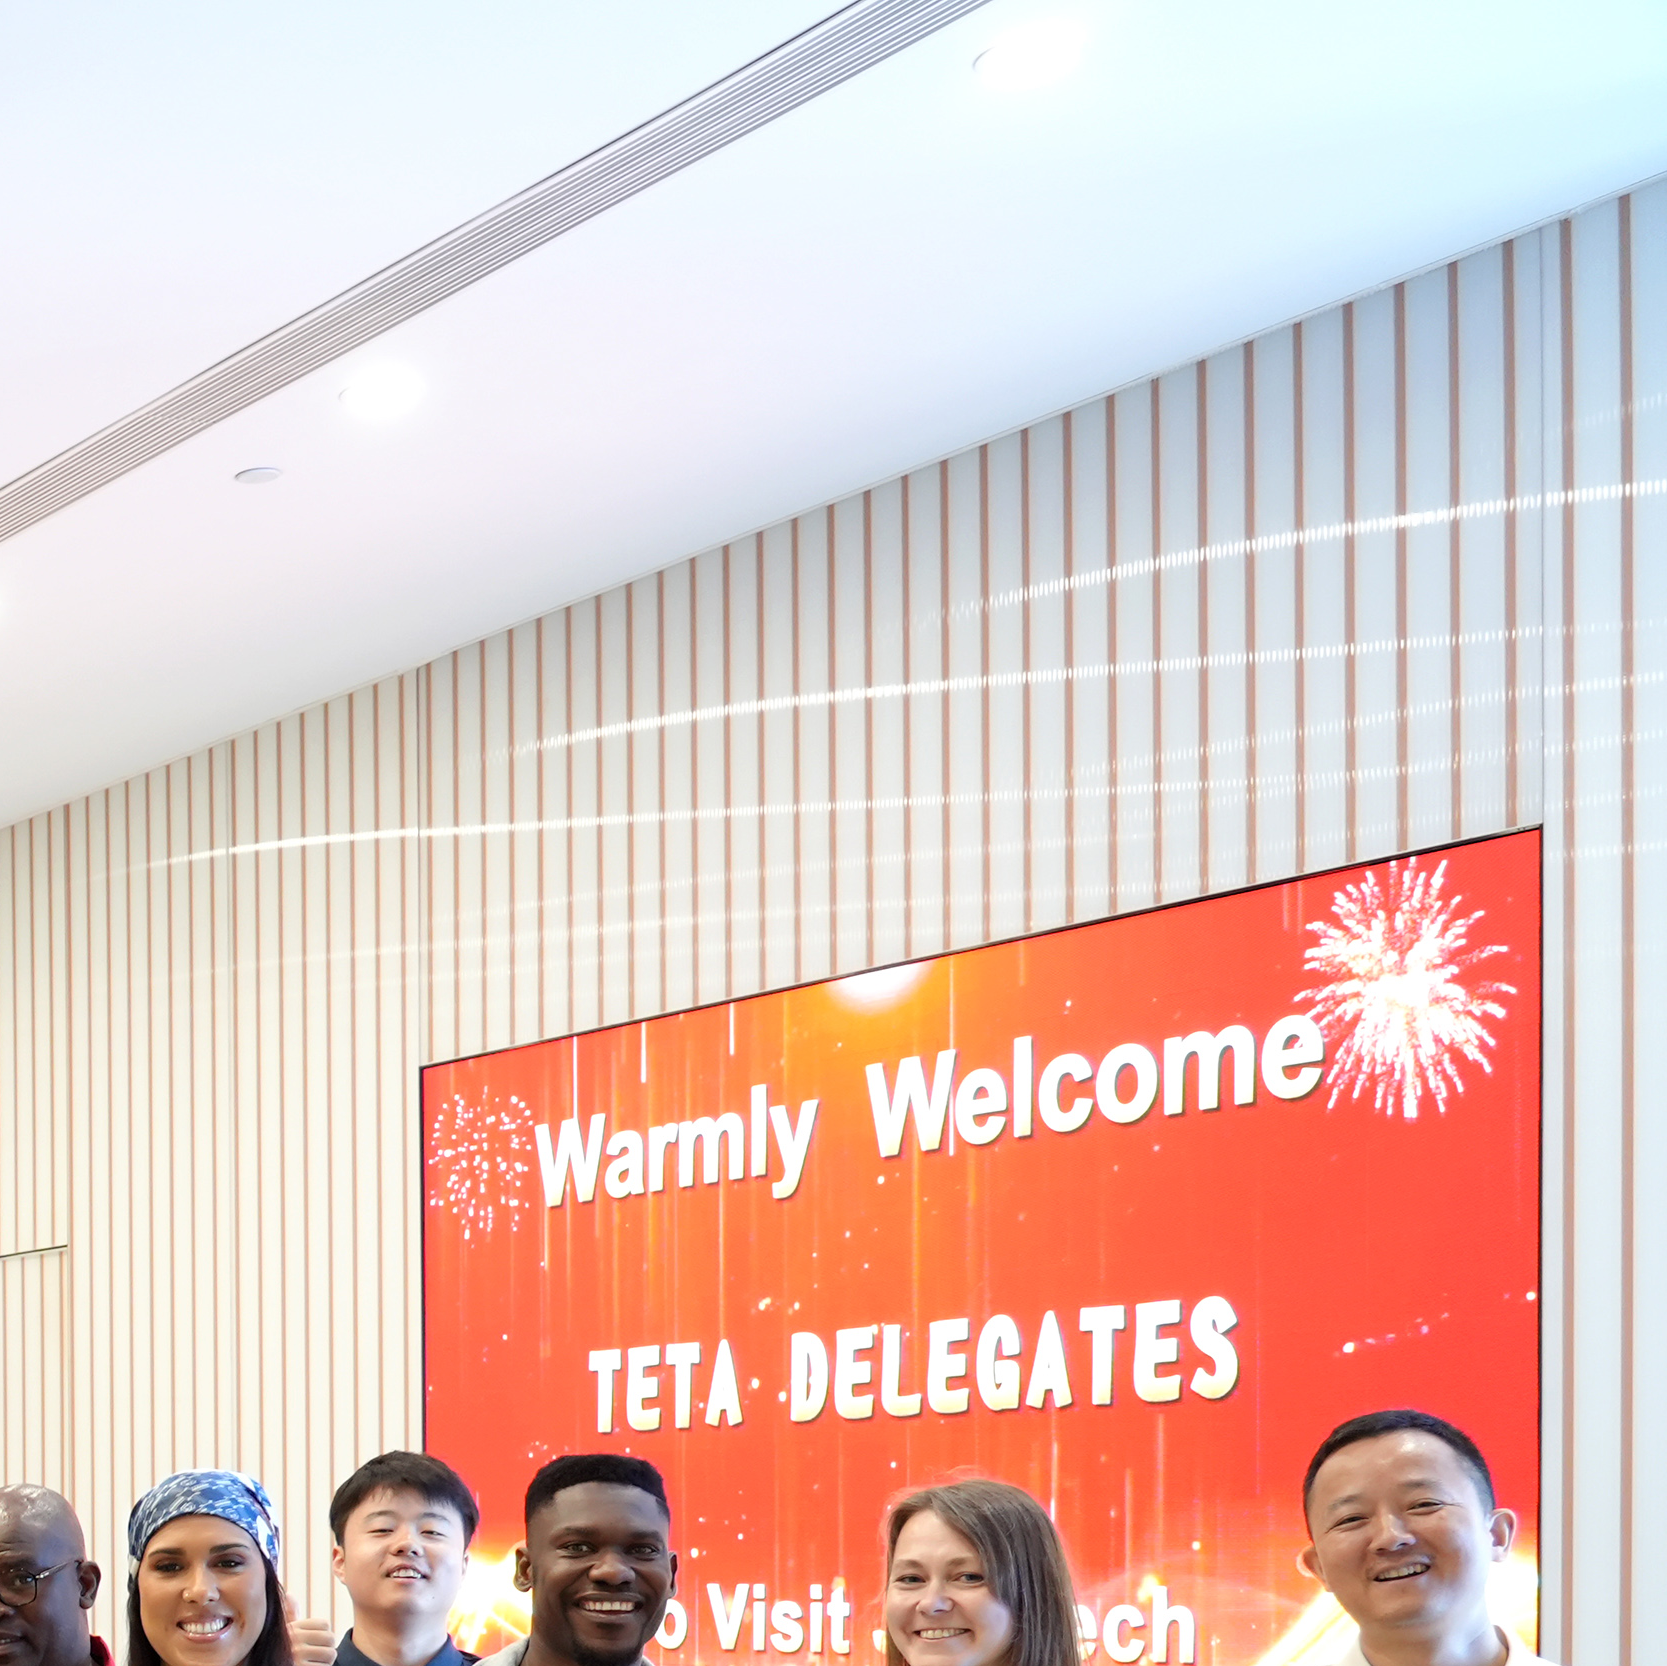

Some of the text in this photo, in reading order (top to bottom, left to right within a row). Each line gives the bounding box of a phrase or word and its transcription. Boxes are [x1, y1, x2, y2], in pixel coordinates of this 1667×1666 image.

[535, 1014, 1325, 1207] Warmly Welcome
[589, 1295, 1239, 1433] TETA DELEGATES
[654, 1597, 688, 1650] o
[707, 1582, 850, 1655] Visit
